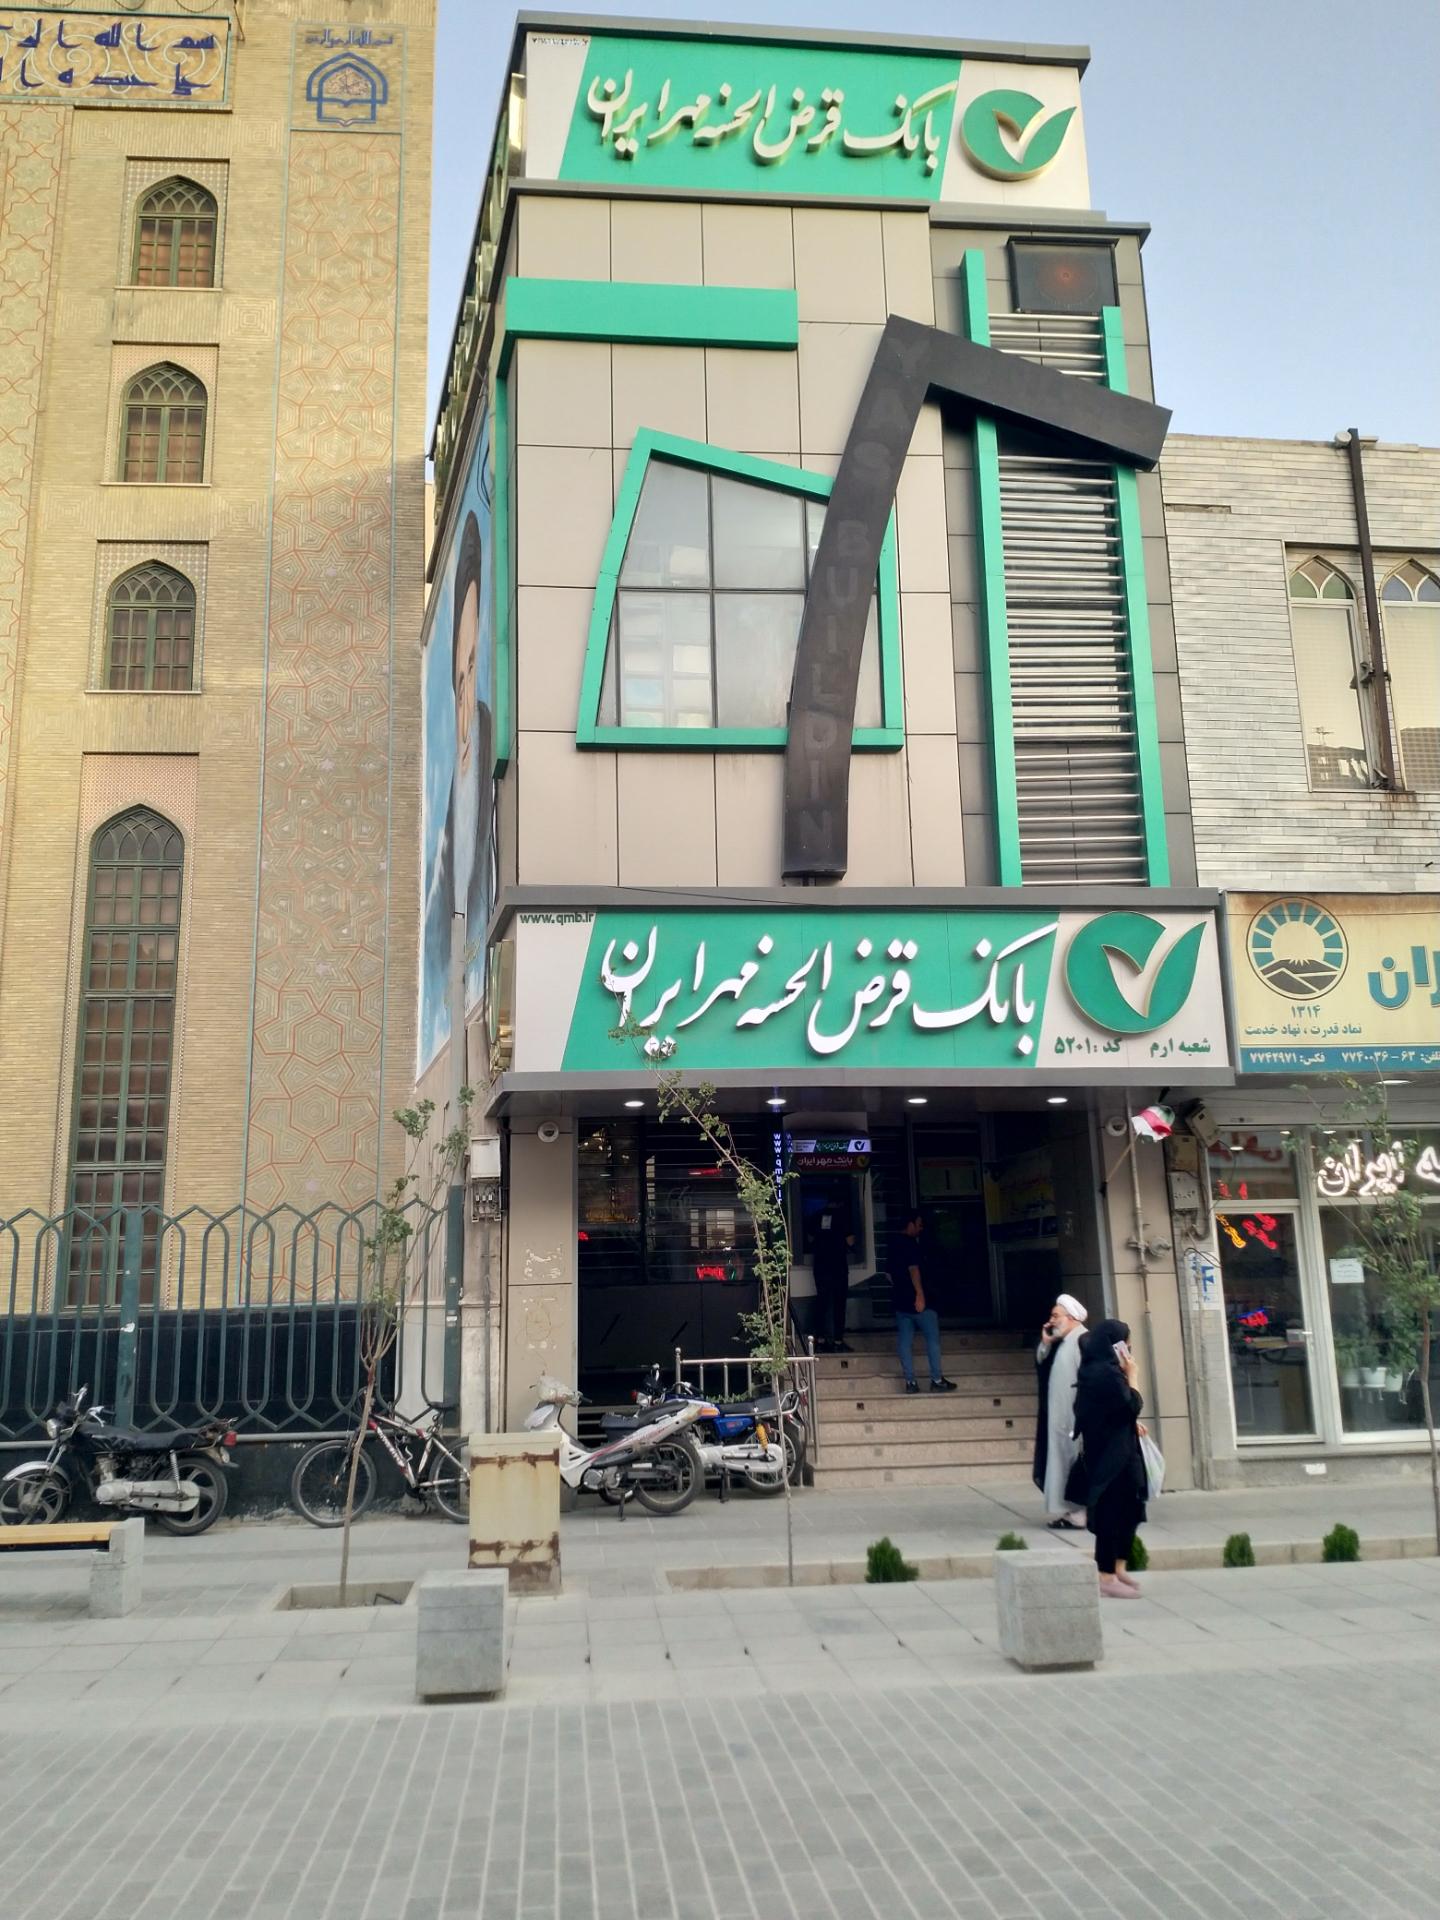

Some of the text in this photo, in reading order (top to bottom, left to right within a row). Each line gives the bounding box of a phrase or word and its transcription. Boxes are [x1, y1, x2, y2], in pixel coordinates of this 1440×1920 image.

[587, 68, 959, 174] بانک قرض الحسنه مهر ایران
[519, 911, 595, 926] www.qmb.ir
[600, 920, 1060, 1058] بانک قرض الحسنه مهر ایران
[1290, 1004, 1321, 1019] ۱۳۱۴
[1244, 1023, 1279, 1036] خدمت
[1281, 1023, 1301, 1037] نهاد
[1310, 1022, 1340, 1039] قدرت
[1341, 1023, 1363, 1036] نماد
[1150, 1037, 1175, 1059] ارم
[1178, 1037, 1212, 1057] شعبه
[1299, 1051, 1326, 1066] فکس:
